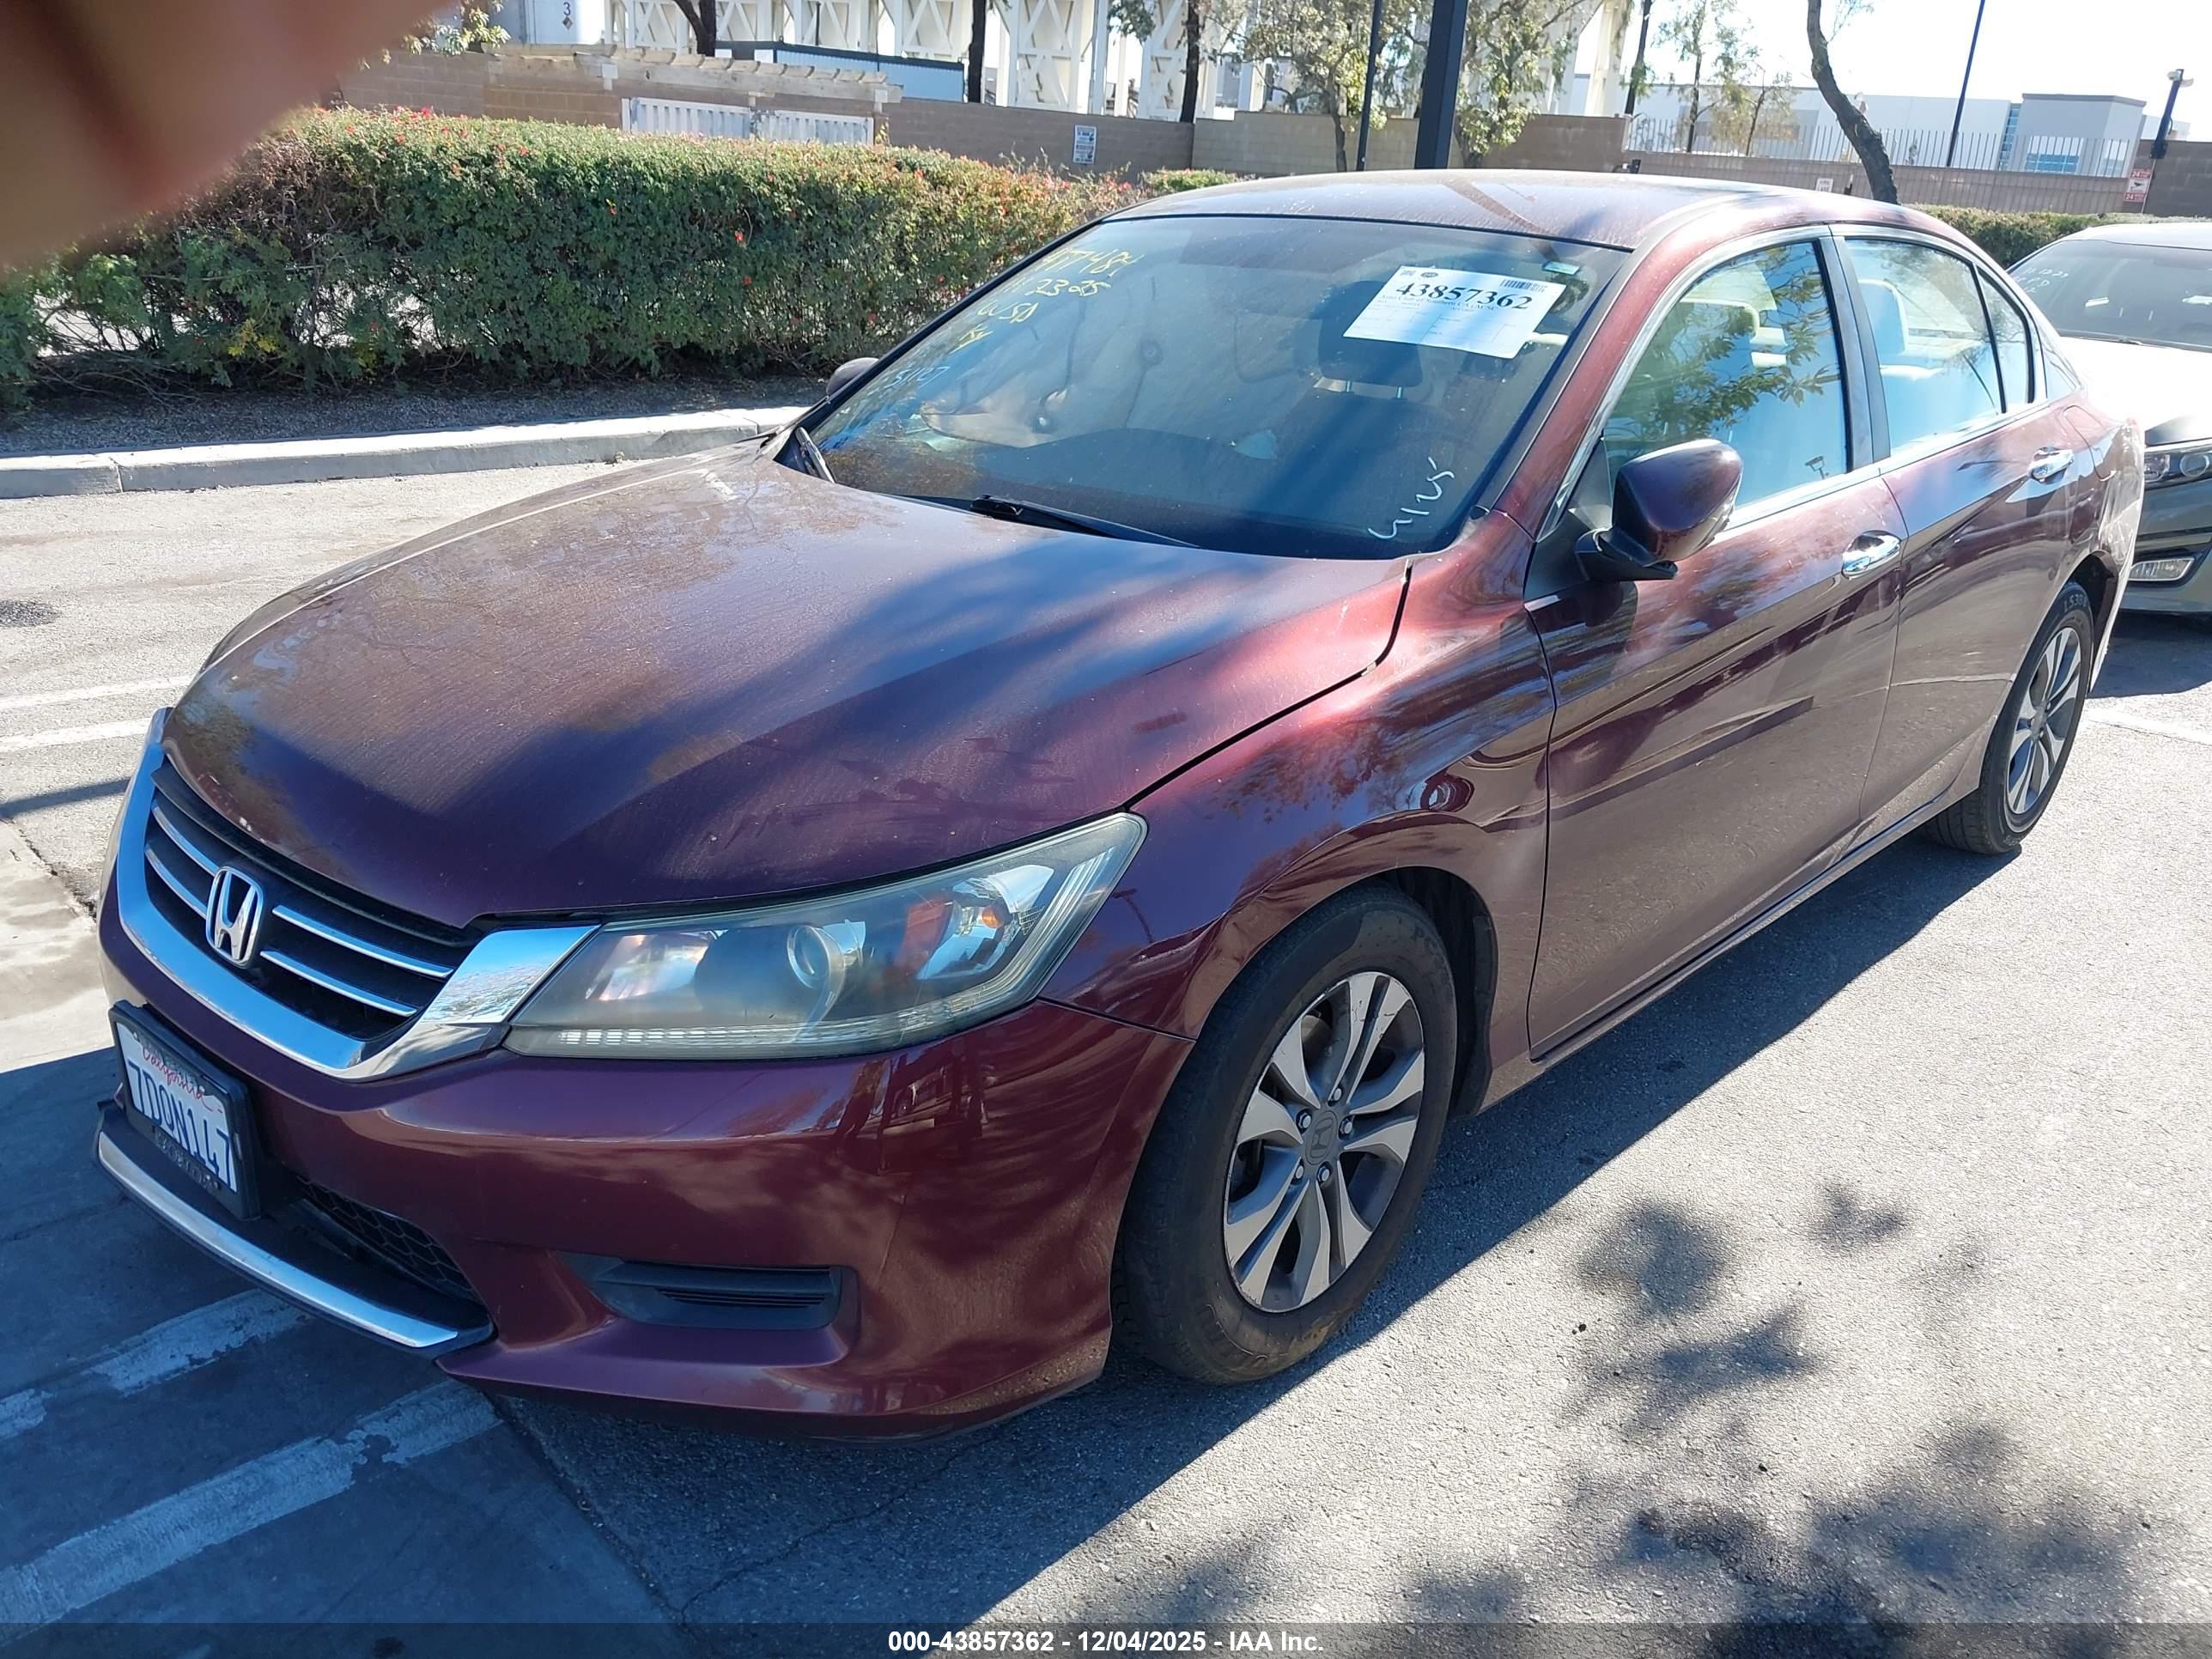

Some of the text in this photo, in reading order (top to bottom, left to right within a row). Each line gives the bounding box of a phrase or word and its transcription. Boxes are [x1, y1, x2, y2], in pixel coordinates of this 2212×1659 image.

[562, 2, 571, 16] 3
[1395, 282, 1534, 311] 43857362
[142, 1043, 209, 1107] California
